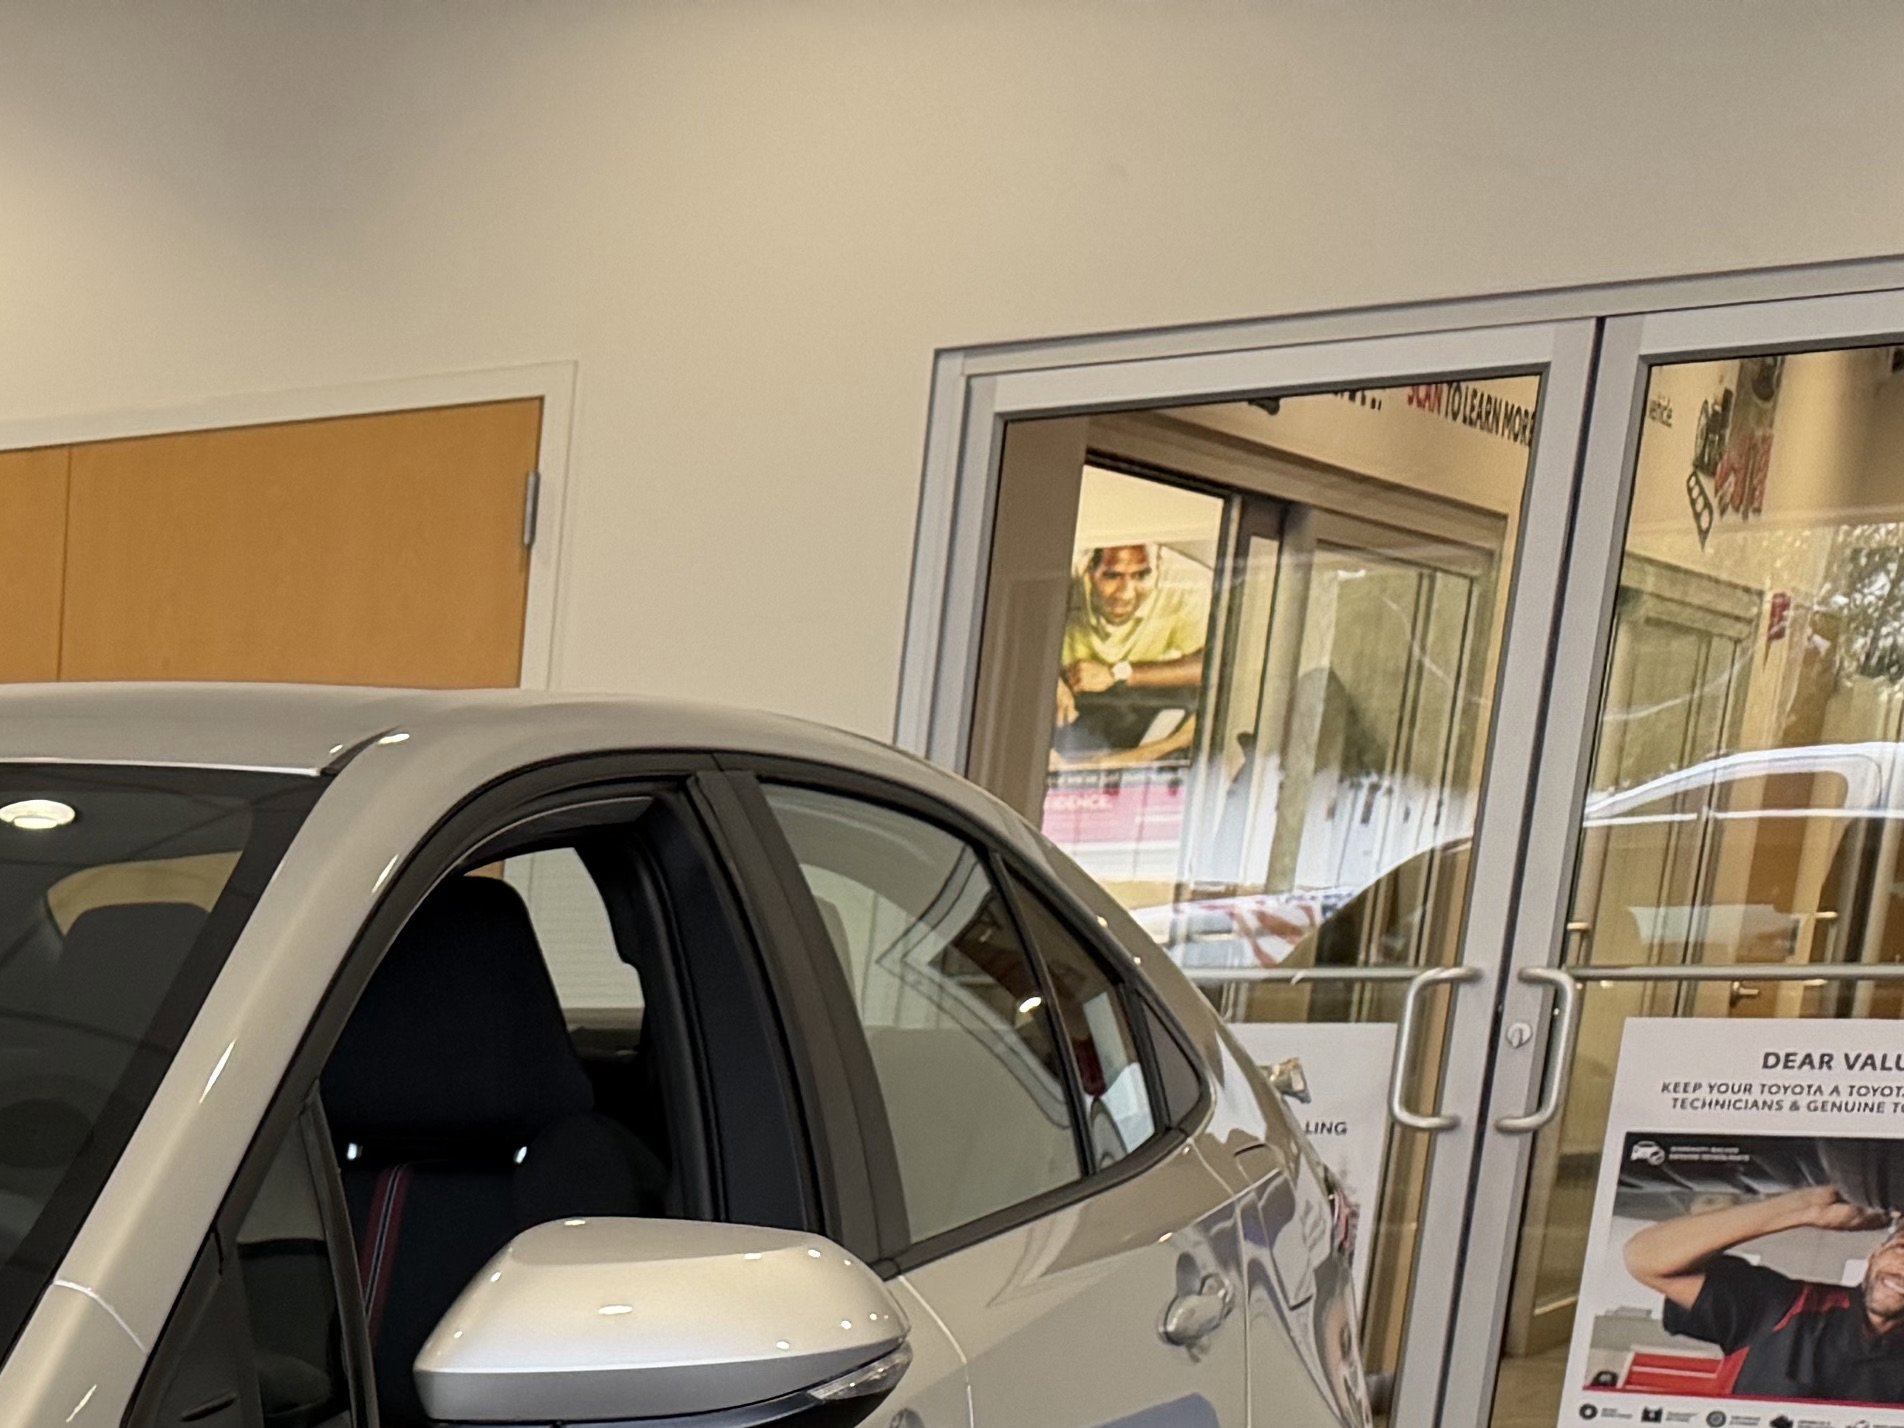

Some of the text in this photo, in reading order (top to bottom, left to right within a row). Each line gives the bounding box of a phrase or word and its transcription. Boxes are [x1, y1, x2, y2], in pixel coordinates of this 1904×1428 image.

[1463, 386, 1502, 435] LEARN
[1761, 1051, 1834, 1071] DEAR
[1661, 1081, 1904, 1098] KEEP YOUR TOYOTA A TOYOT
[1671, 1097, 1784, 1112] TECHNICIANS
[1806, 1099, 1886, 1114] GENUINE
